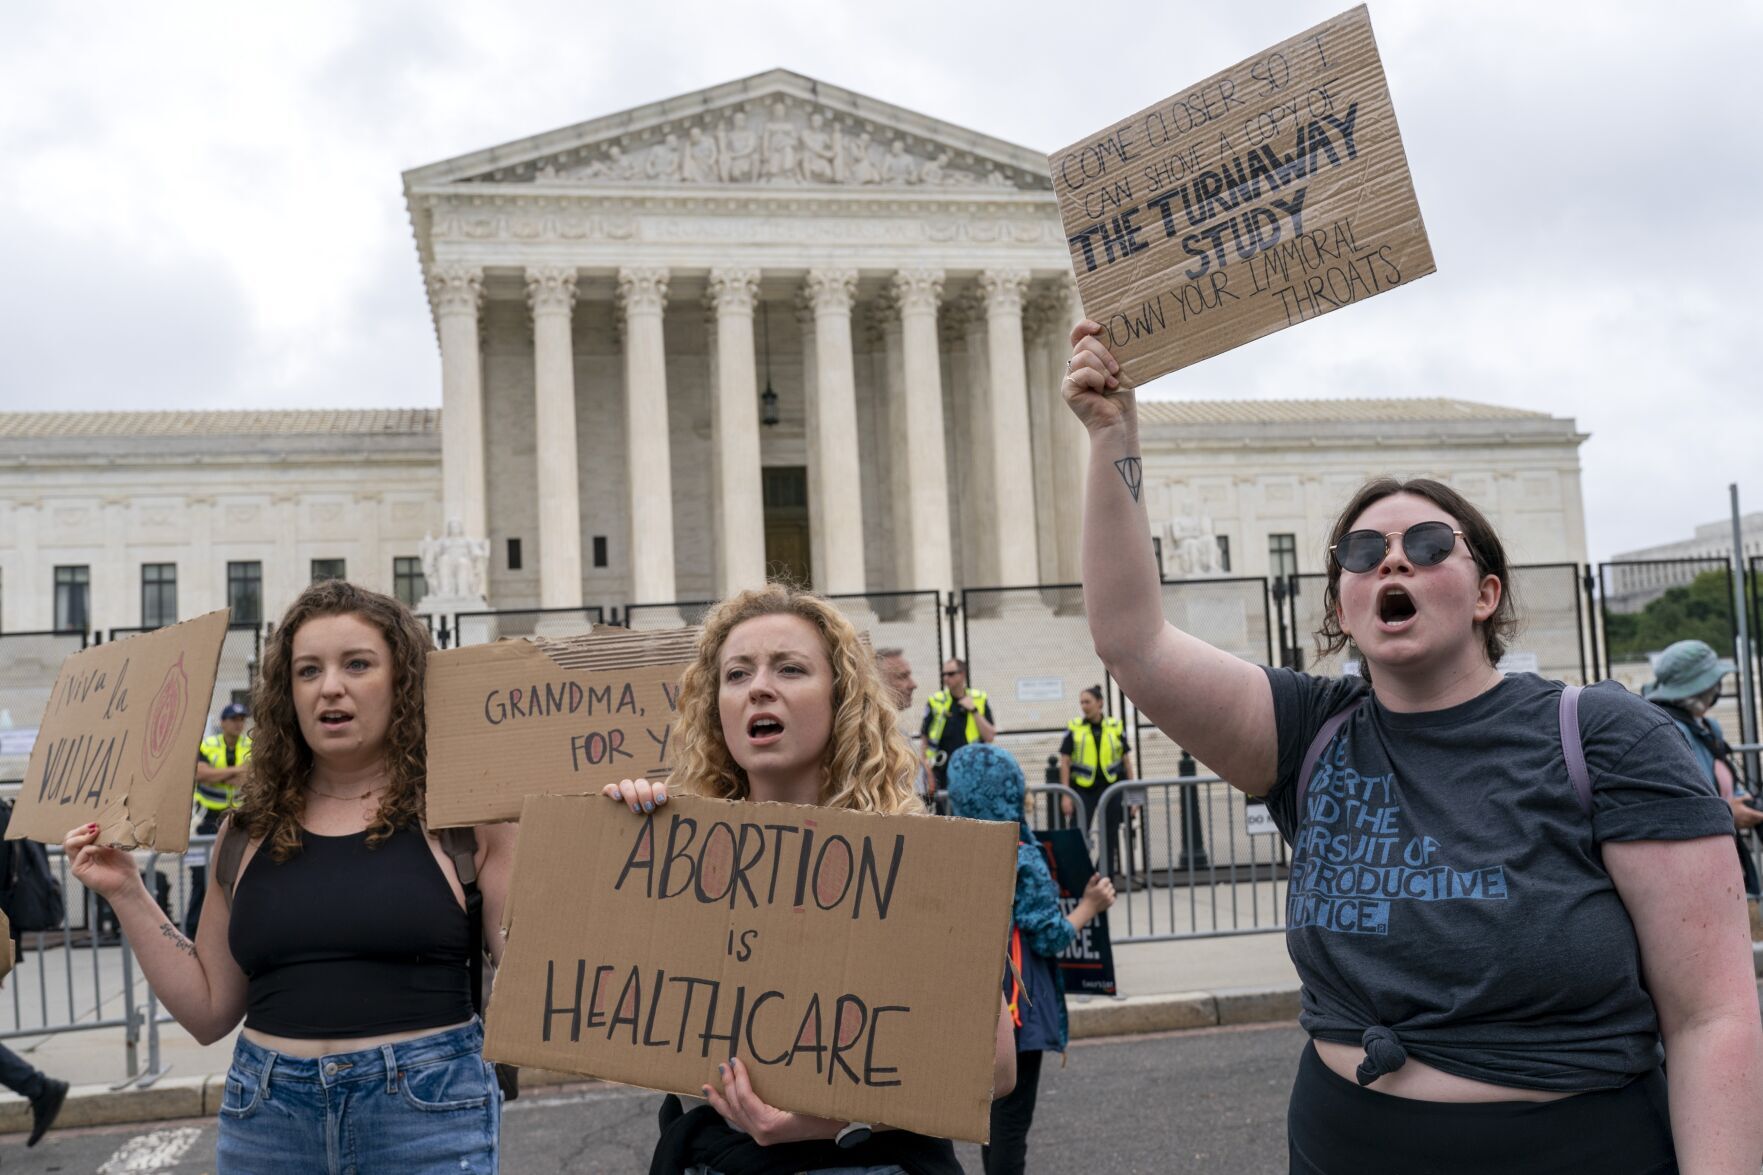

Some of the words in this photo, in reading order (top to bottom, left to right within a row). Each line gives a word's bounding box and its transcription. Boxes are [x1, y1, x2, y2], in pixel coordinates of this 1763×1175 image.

[1061, 124, 1142, 191] COME
[1145, 79, 1246, 148] CLOSER
[1250, 53, 1290, 98] SO
[1303, 30, 1338, 70] I
[1084, 176, 1134, 220] CAN
[1144, 141, 1214, 193] SHOVE
[1219, 130, 1237, 161] A
[1244, 96, 1300, 147] COPY
[1307, 77, 1340, 118] OF
[1069, 206, 1149, 273] THE
[1146, 101, 1359, 240] TURNAWAY
[1169, 270, 1241, 323] YOUR
[1240, 216, 1371, 298] IMMORAL
[1181, 187, 1307, 281] STUDY
[1271, 244, 1402, 326] THROATS
[103, 657, 130, 720] la
[484, 680, 646, 725] GRANDMA,
[38, 729, 129, 810] VULVA!
[570, 728, 634, 772] FOR
[1303, 793, 1342, 824] ND
[1345, 799, 1401, 834] THE
[1402, 835, 1442, 866] OF
[614, 813, 905, 921] ABORTION
[542, 959, 911, 1088] HEALTHCARE
